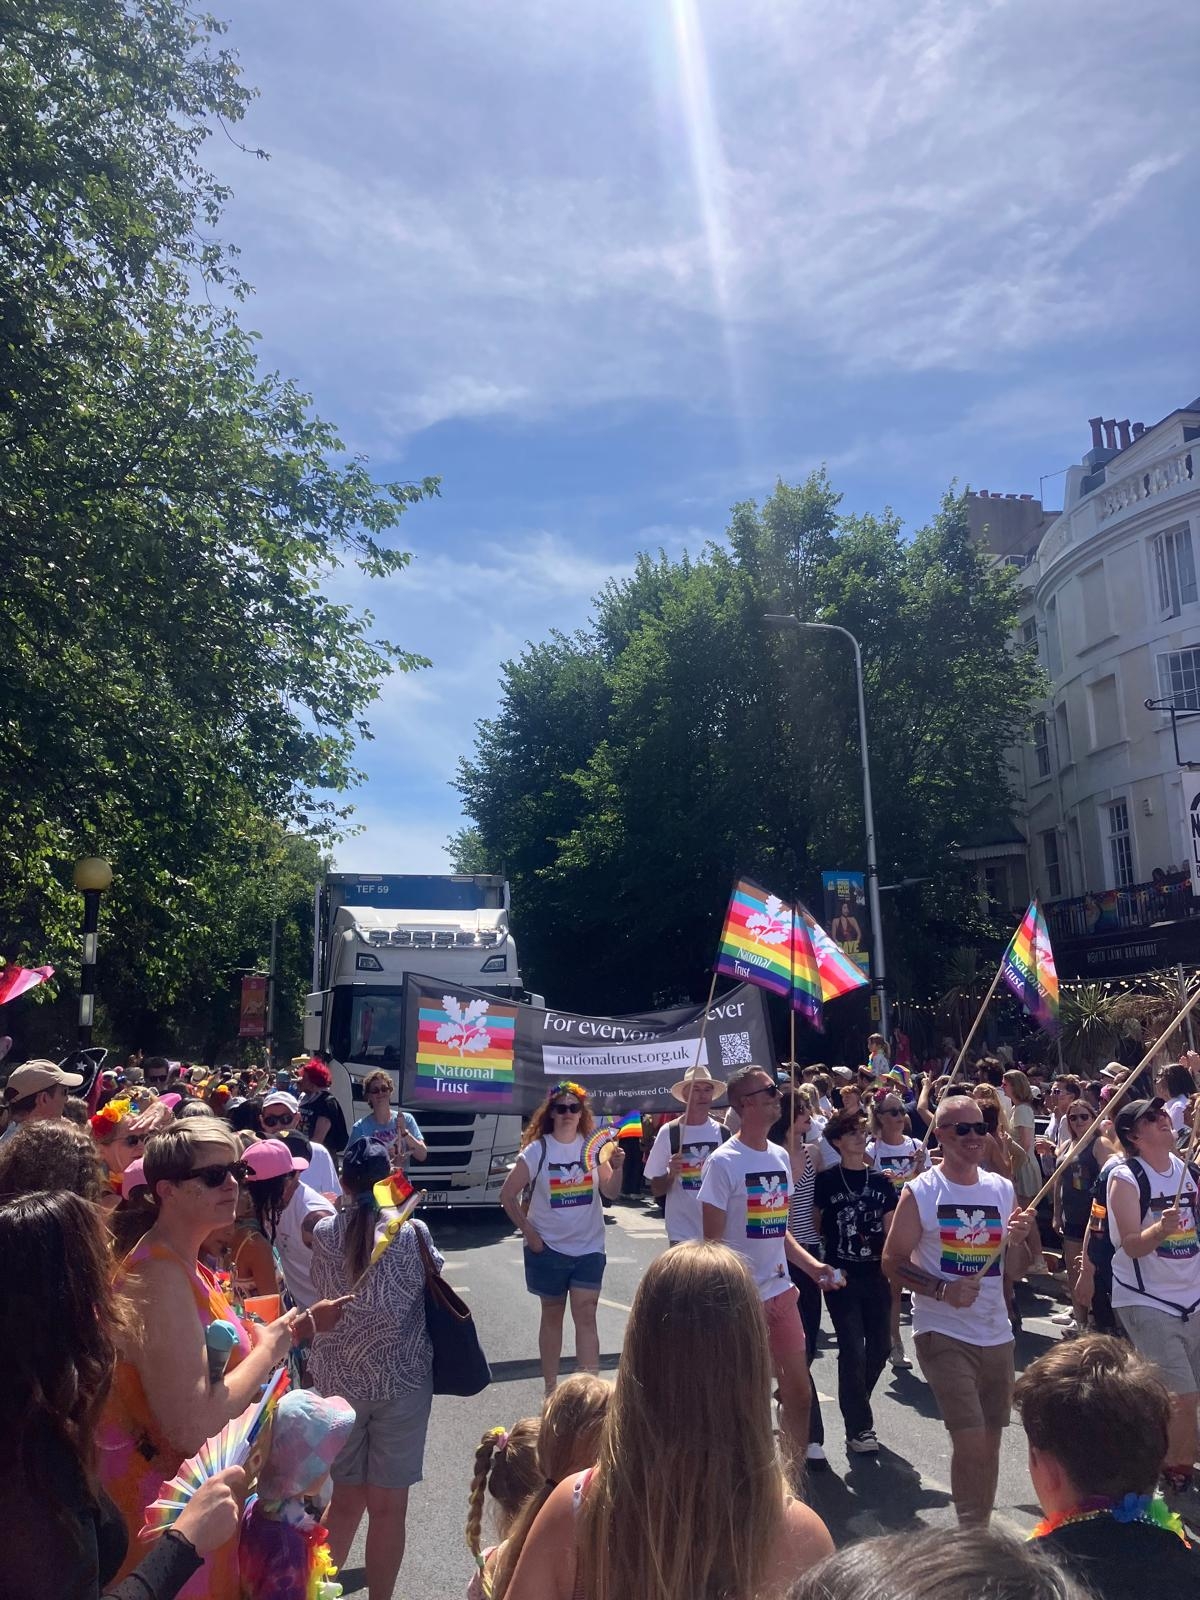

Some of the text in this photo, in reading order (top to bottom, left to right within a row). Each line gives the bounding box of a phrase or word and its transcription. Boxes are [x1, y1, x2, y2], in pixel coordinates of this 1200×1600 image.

[356, 885, 389, 894] TEF 59
[734, 960, 750, 978] Trust
[1004, 962, 1025, 989] Trust
[543, 1012, 576, 1032] For
[557, 1046, 690, 1066] nationaltrust.org.uk
[434, 1062, 494, 1080] National
[433, 1077, 470, 1094] Trust
[599, 1089, 617, 1097] Trust
[618, 1087, 657, 1098] Registered
[760, 1226, 780, 1235] Trust
[956, 1252, 990, 1263] Nation
[1171, 1247, 1191, 1256] Trust
[956, 1261, 979, 1272] Trust
